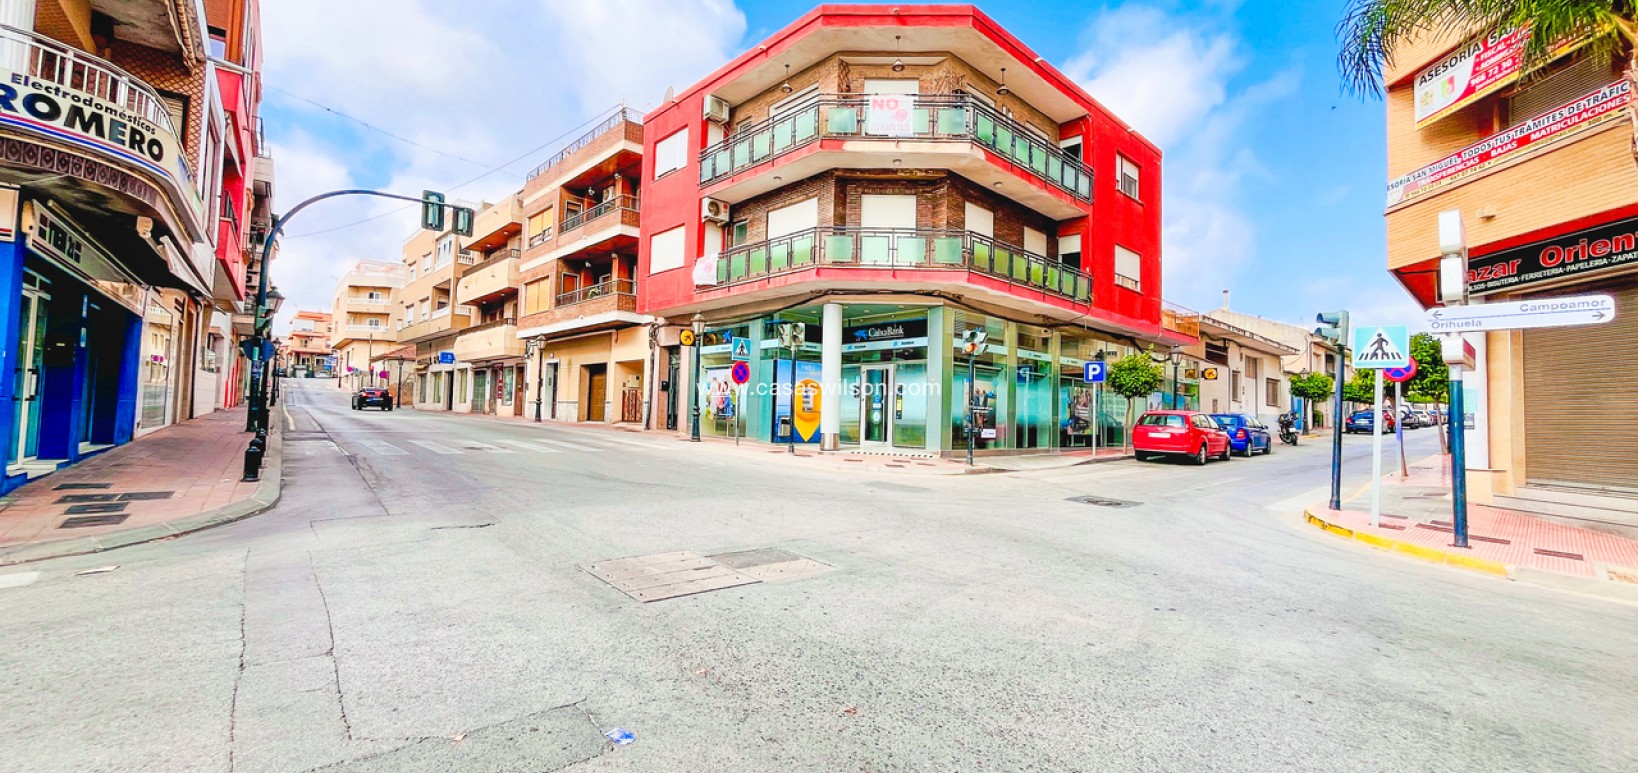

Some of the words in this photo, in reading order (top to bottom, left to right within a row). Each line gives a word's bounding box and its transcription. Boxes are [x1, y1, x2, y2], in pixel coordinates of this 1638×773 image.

[1480, 42, 1507, 60] FISCAL
[1487, 66, 1499, 78] 72
[1500, 59, 1513, 71] 30
[11, 72, 156, 135] Electrodomésticos
[872, 98, 899, 110] NO
[0, 82, 165, 162] ROMERO
[1490, 140, 1518, 157] BAJAS
[1530, 94, 1630, 141] MATRICULACIONES
[1412, 170, 1427, 181] SAN
[1463, 141, 1493, 158] TODOS
[1495, 132, 1511, 146] TUS
[1567, 102, 1583, 115] DE
[1566, 257, 1608, 272] PAPELERIA
[1519, 299, 1606, 313] Campoamor
[868, 325, 905, 338] CaixaBank
[1431, 319, 1482, 329] Orihuela
[1088, 364, 1101, 380] P
